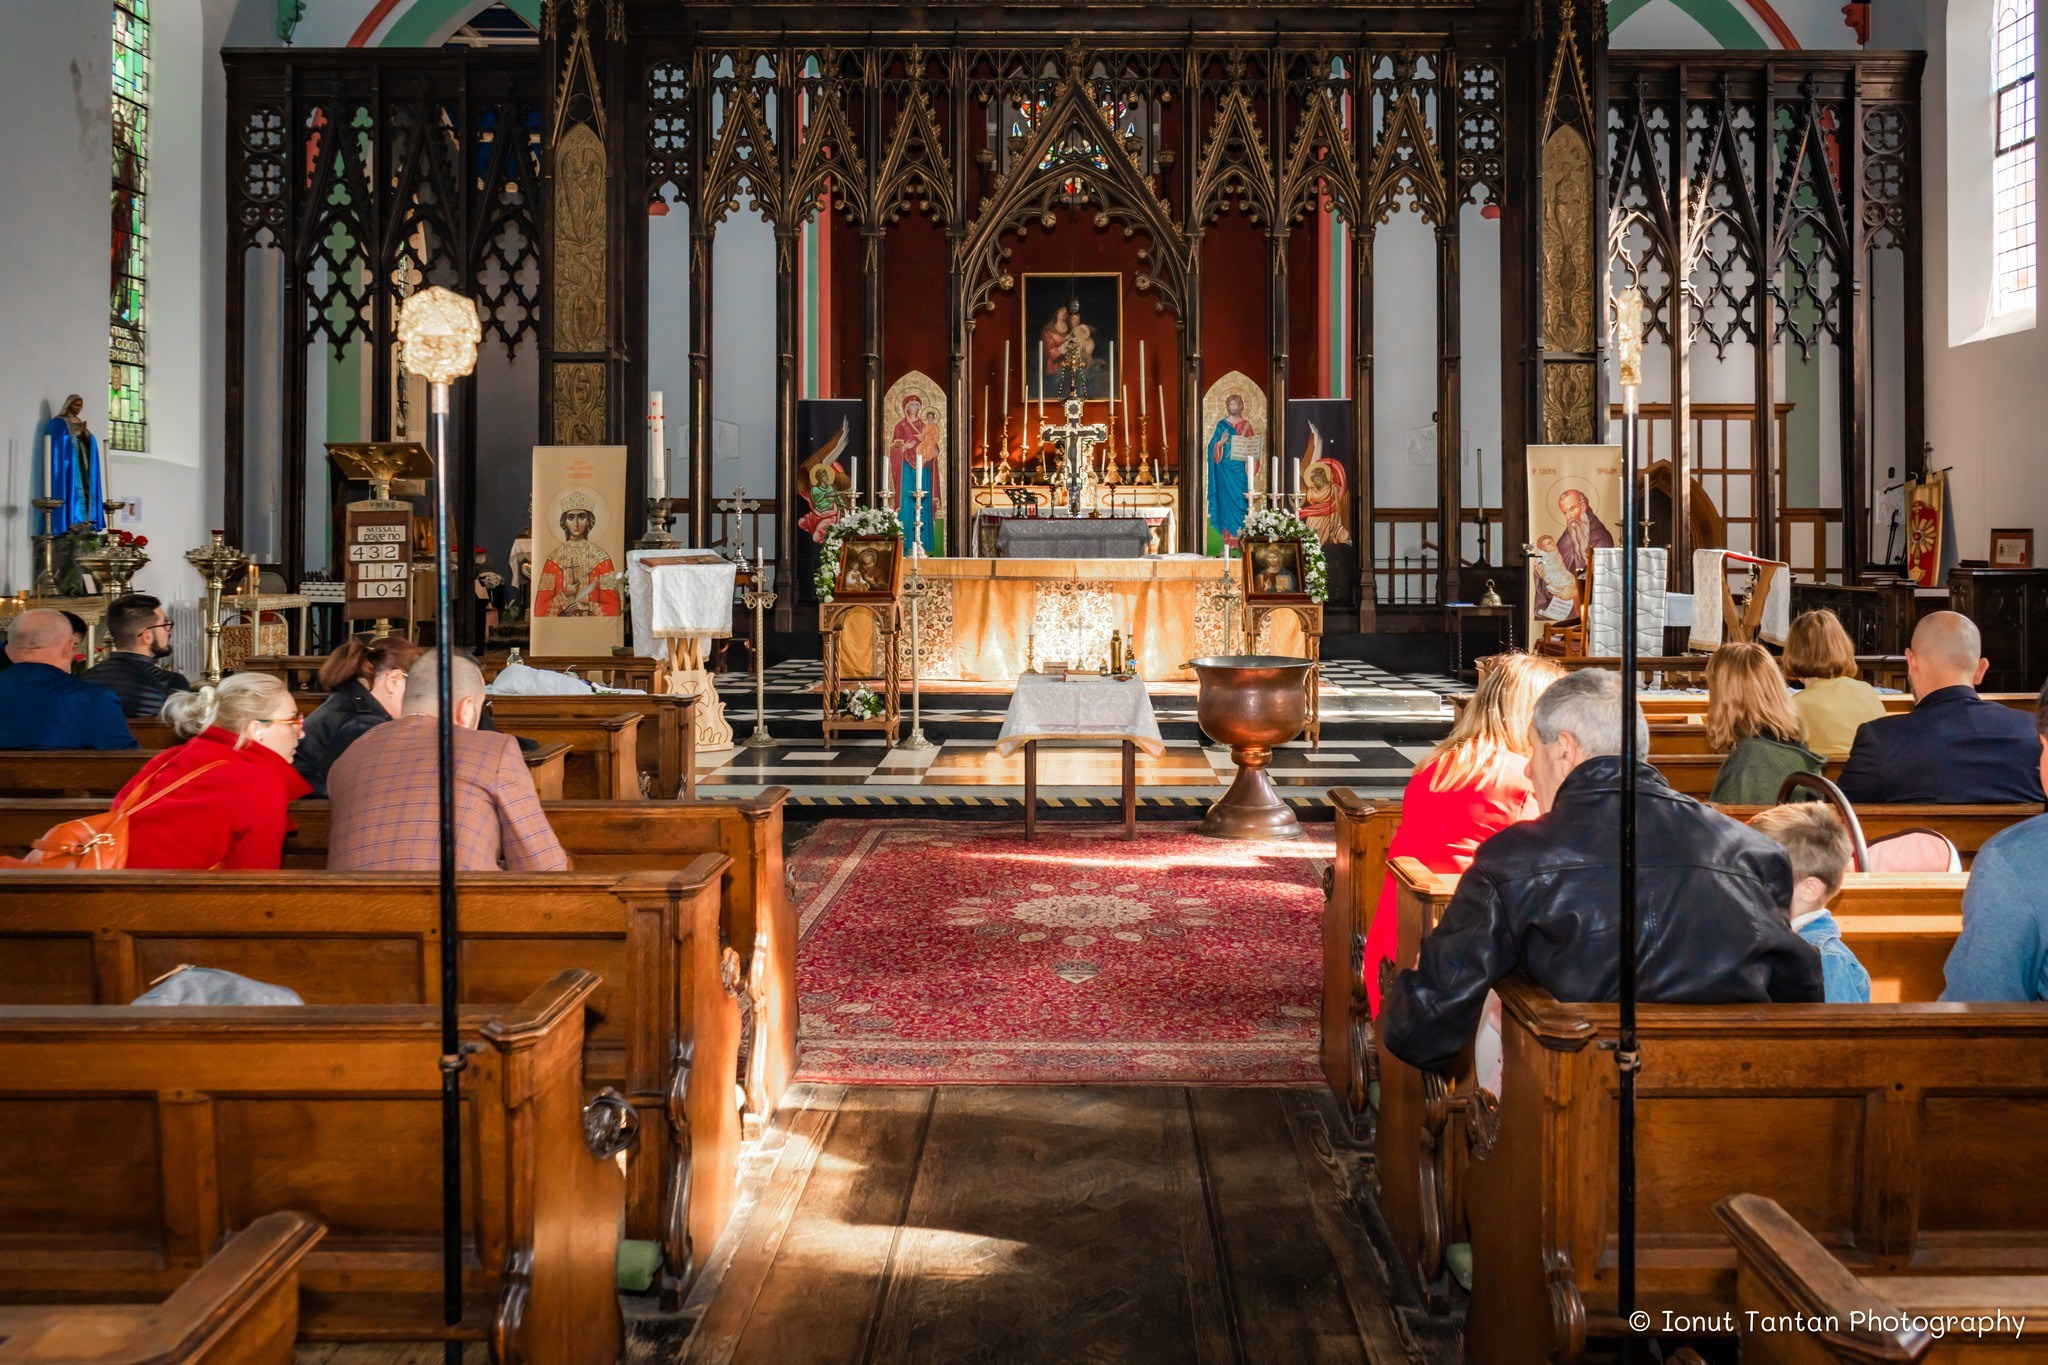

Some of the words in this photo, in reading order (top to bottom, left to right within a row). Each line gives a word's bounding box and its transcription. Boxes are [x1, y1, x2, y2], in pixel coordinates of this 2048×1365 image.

[363, 533, 386, 542] page
[352, 545, 396, 560] 432
[365, 564, 405, 578] 117
[364, 583, 404, 597] 104
